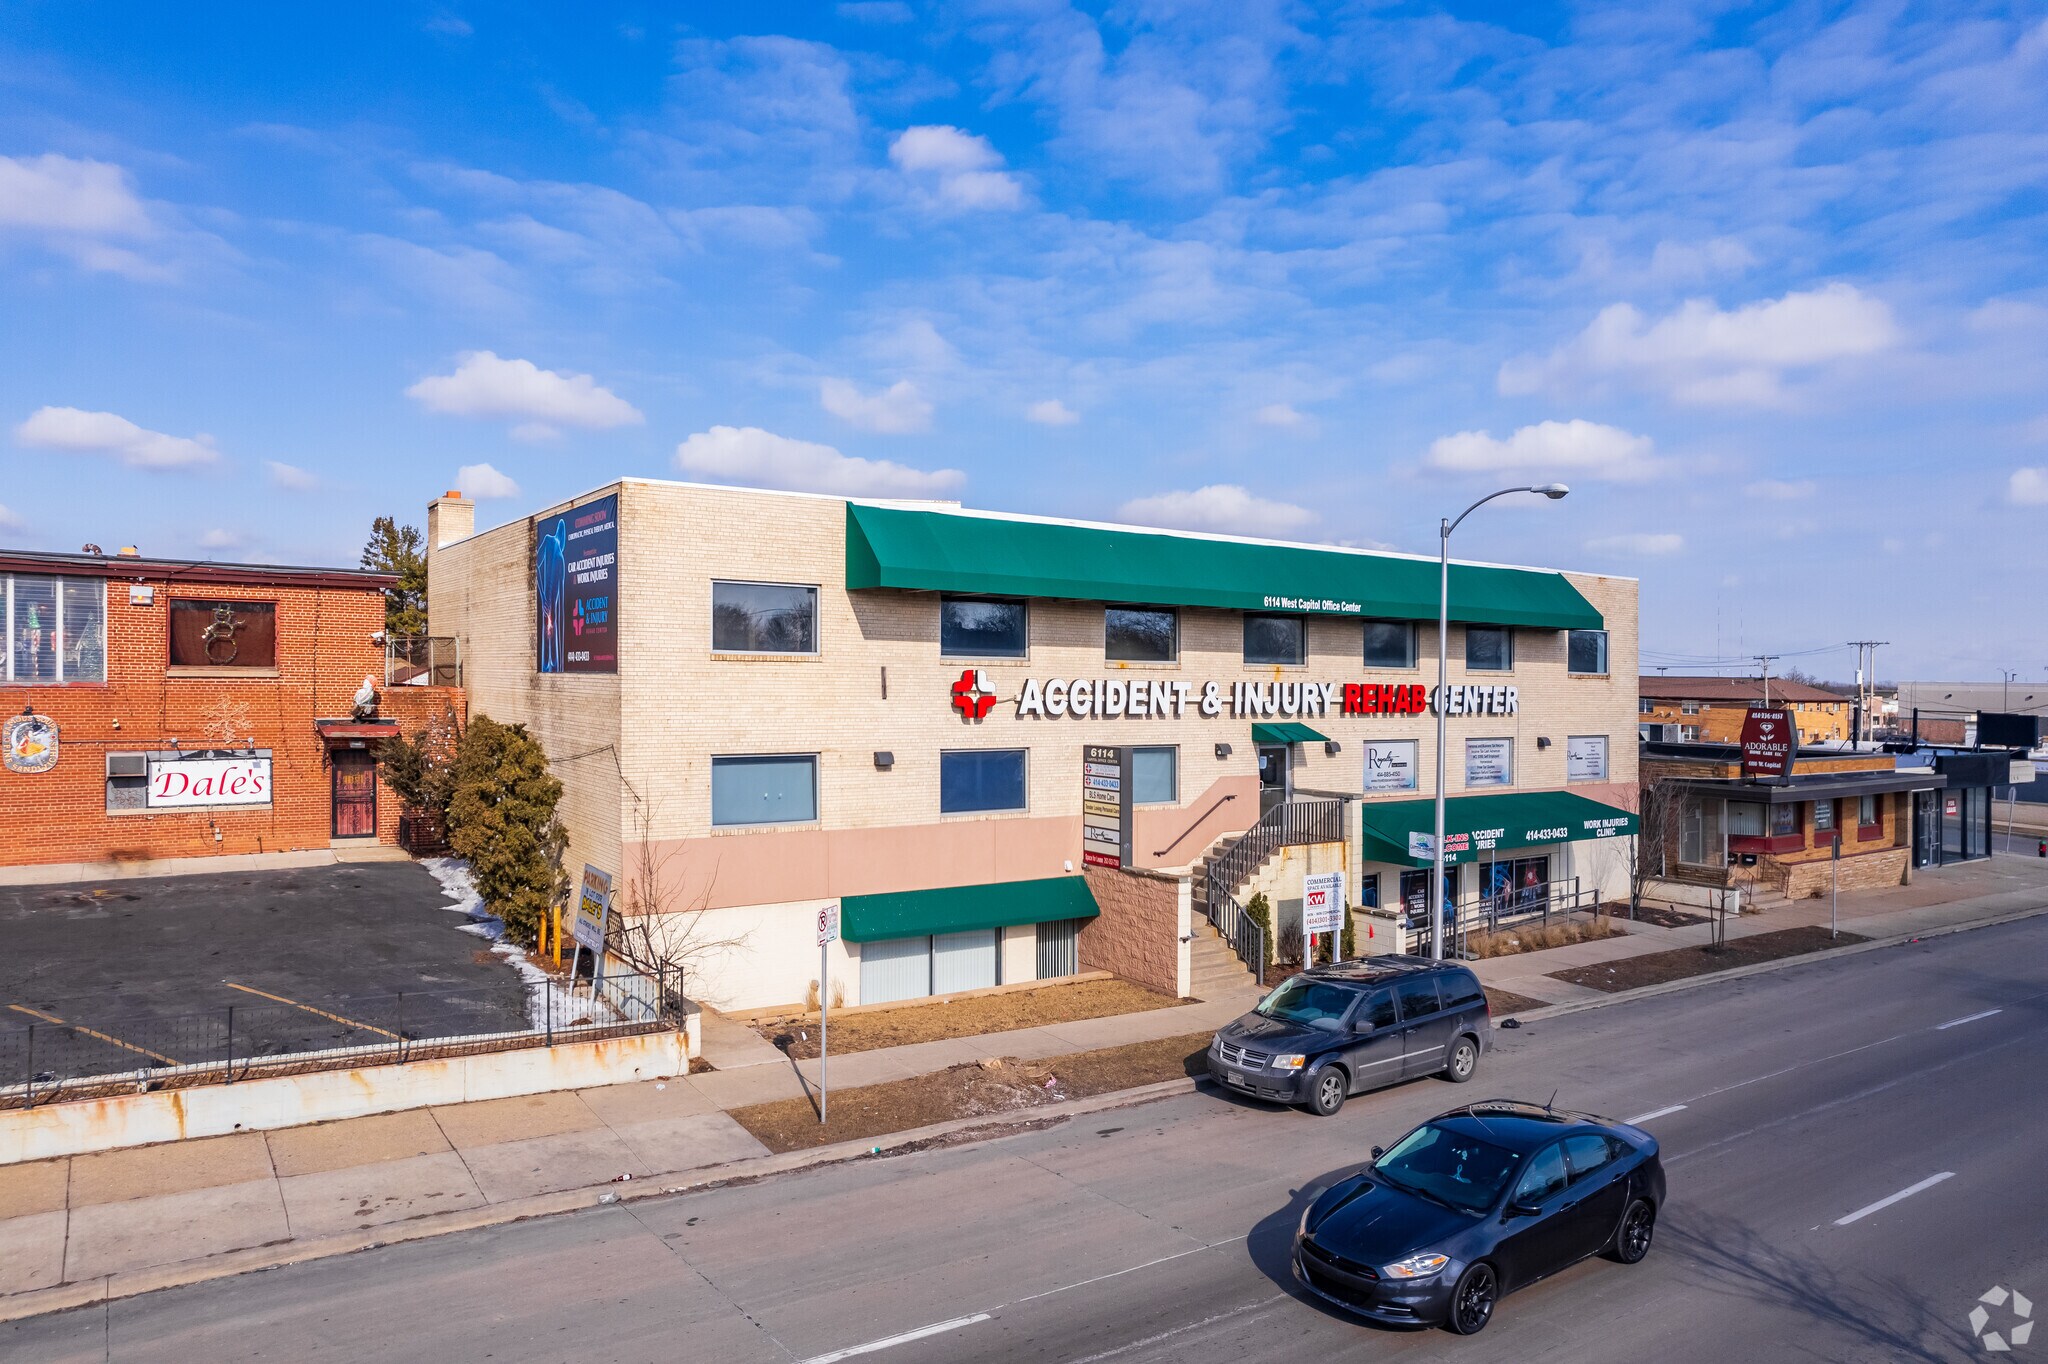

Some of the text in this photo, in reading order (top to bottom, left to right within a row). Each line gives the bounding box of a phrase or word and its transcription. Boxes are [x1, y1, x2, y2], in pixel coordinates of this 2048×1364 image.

[576, 557, 595, 572] ACCIDENT
[596, 552, 615, 569] INJURIES
[576, 573, 590, 584] WORK
[590, 568, 608, 584] INJURIES
[585, 596, 609, 611] ACCIDENT
[1263, 595, 1362, 613] 6114 West Capitol Office Center
[585, 610, 609, 626] & INJURY
[1017, 678, 1520, 716] ACCIDENT & INJURY REHAB CENTER
[1090, 748, 1114, 758] 6114
[1744, 742, 1788, 752] ADORABLE
[1368, 748, 1400, 769] Royalty
[155, 766, 265, 798] Dale's
[1583, 817, 1629, 829] WORK INJURIES
[1525, 827, 1568, 841] 414-433-0433
[1596, 827, 1616, 838] CLINIC
[585, 871, 608, 895] PARKING
[1307, 877, 1342, 886] COMMERCIAL
[582, 895, 603, 919] DALE'S
[1307, 894, 1325, 906] KW
